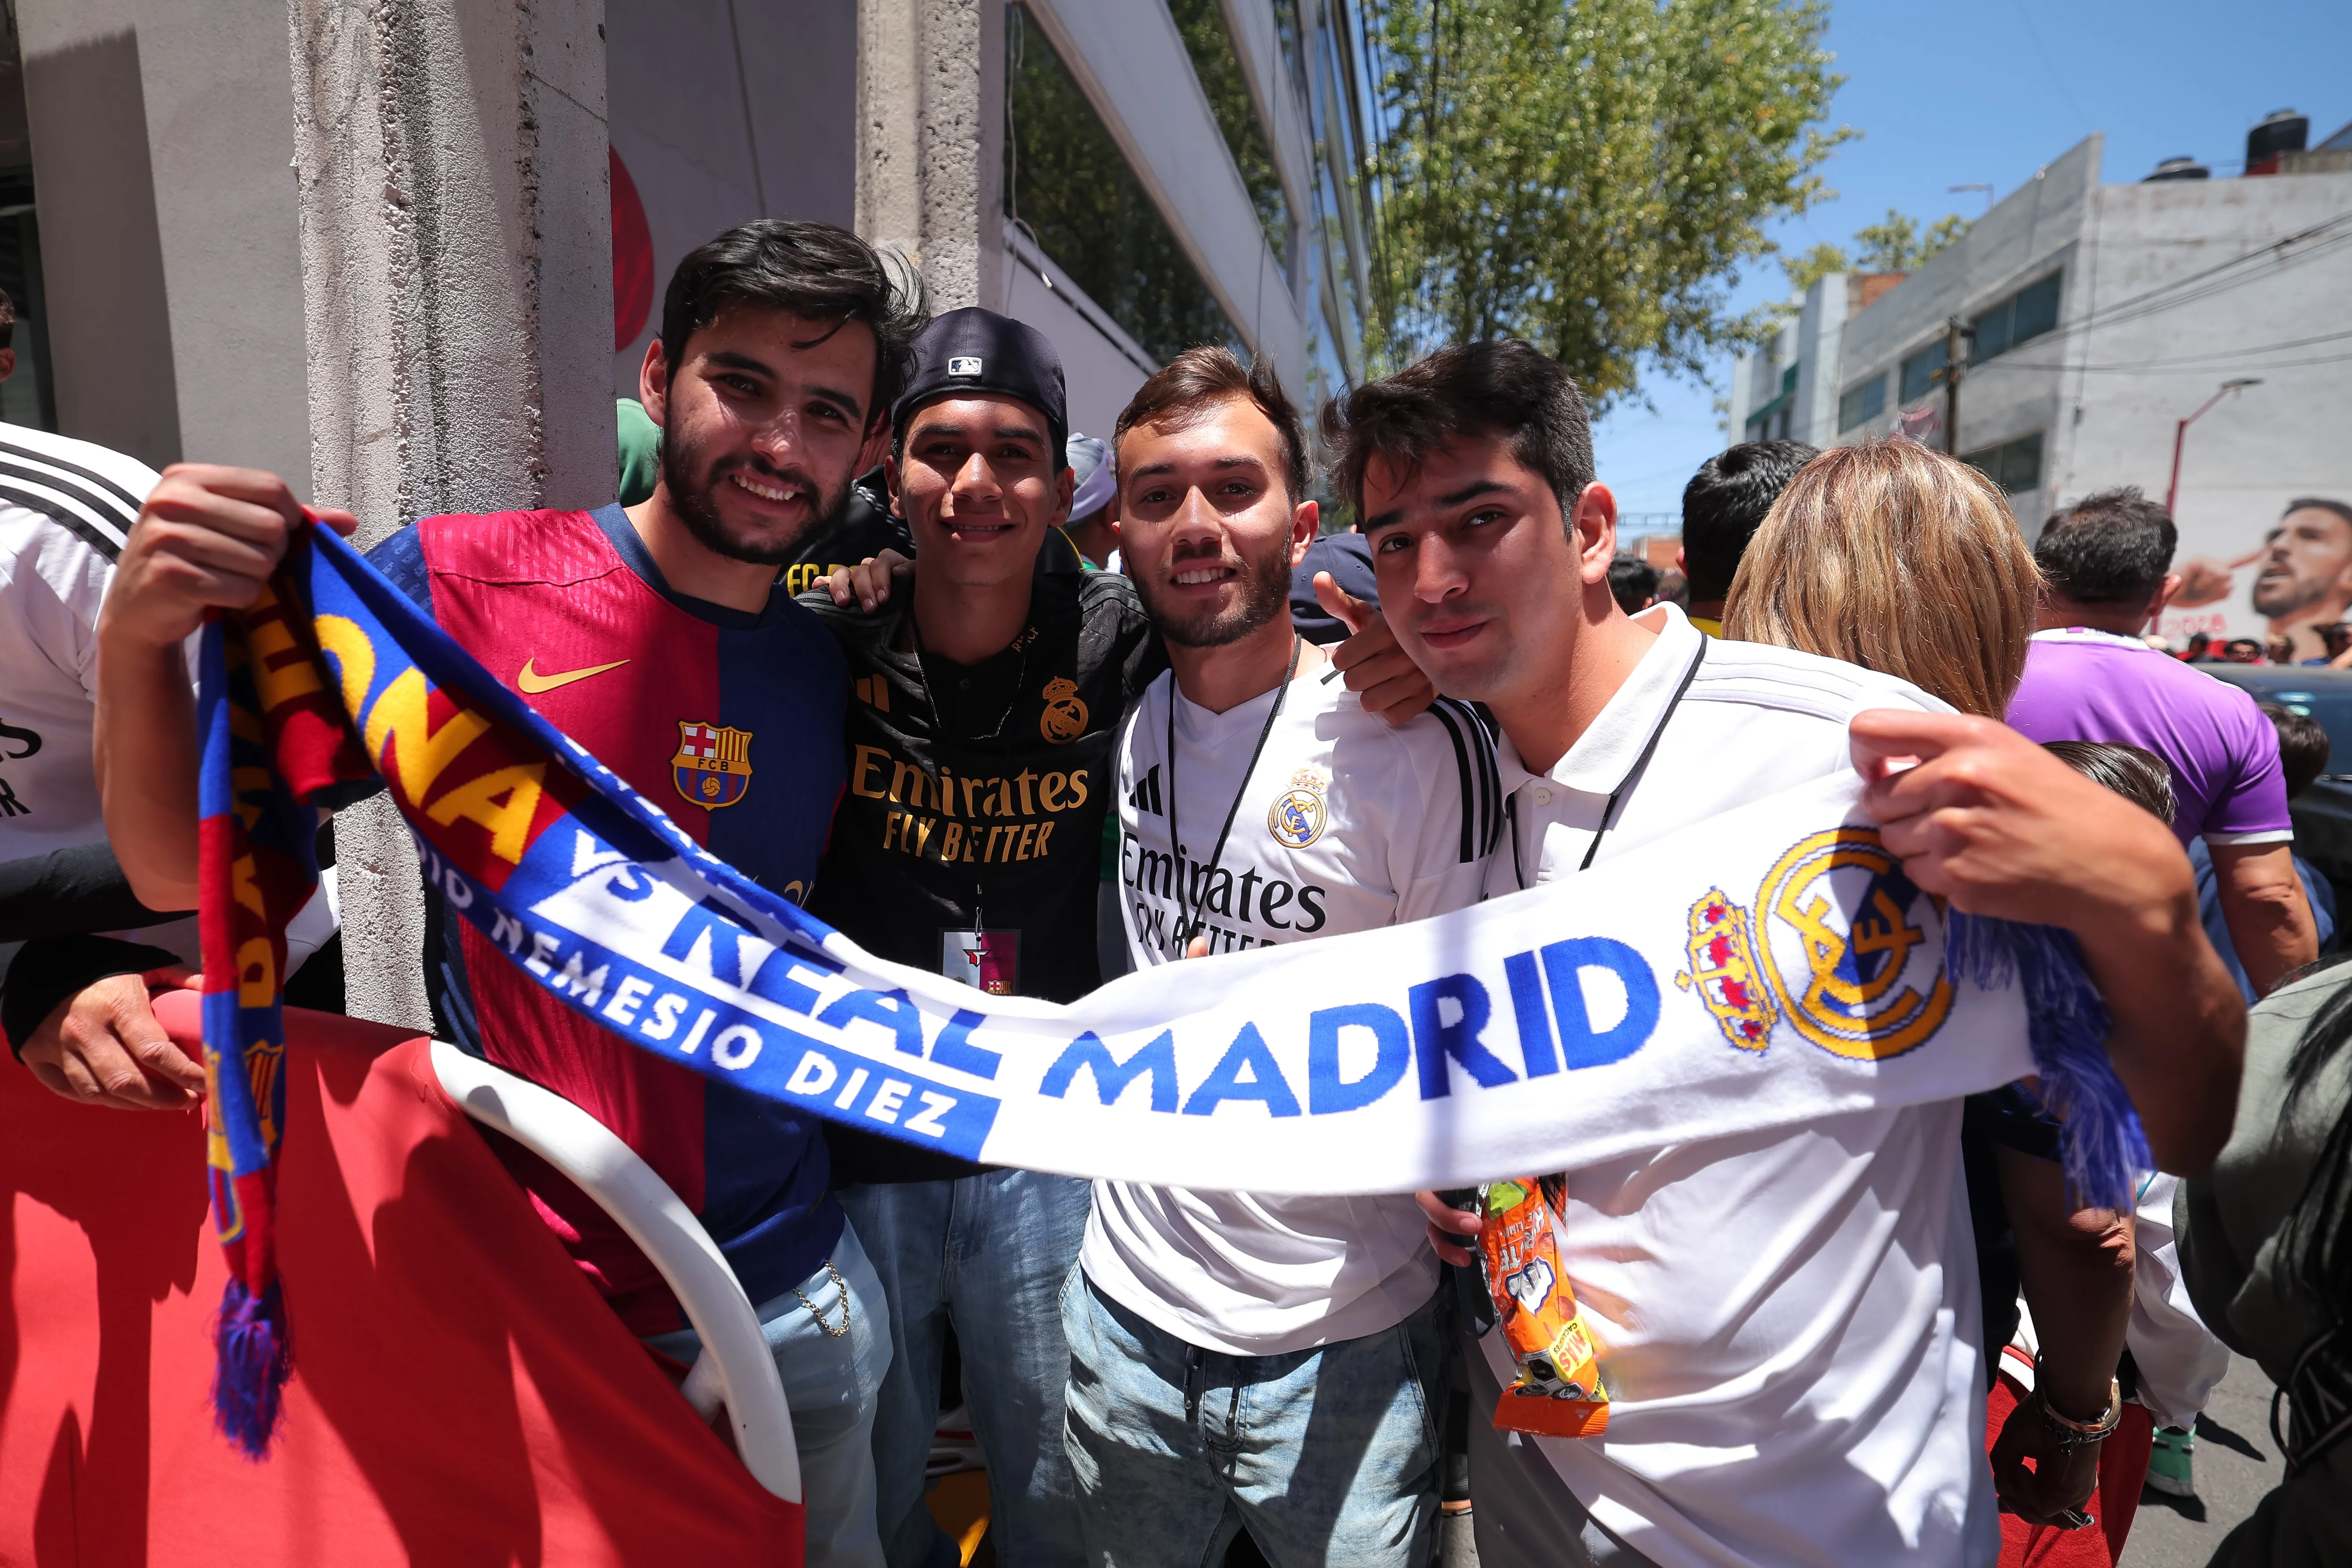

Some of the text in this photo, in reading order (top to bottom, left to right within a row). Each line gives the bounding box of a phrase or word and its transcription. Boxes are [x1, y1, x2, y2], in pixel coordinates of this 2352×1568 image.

[698, 758, 729, 771] FCB
[853, 744, 1088, 817] Emirates
[883, 810, 1055, 863] FLY BETTER
[1122, 831, 1326, 933] Emirates
[1172, 916, 1278, 960] BTT
[491, 906, 762, 1071] NEMESIO
[785, 1050, 958, 1138] DIEZ
[1038, 935, 1661, 1118] MADRID
[1559, 1329, 1586, 1373] MÁS
